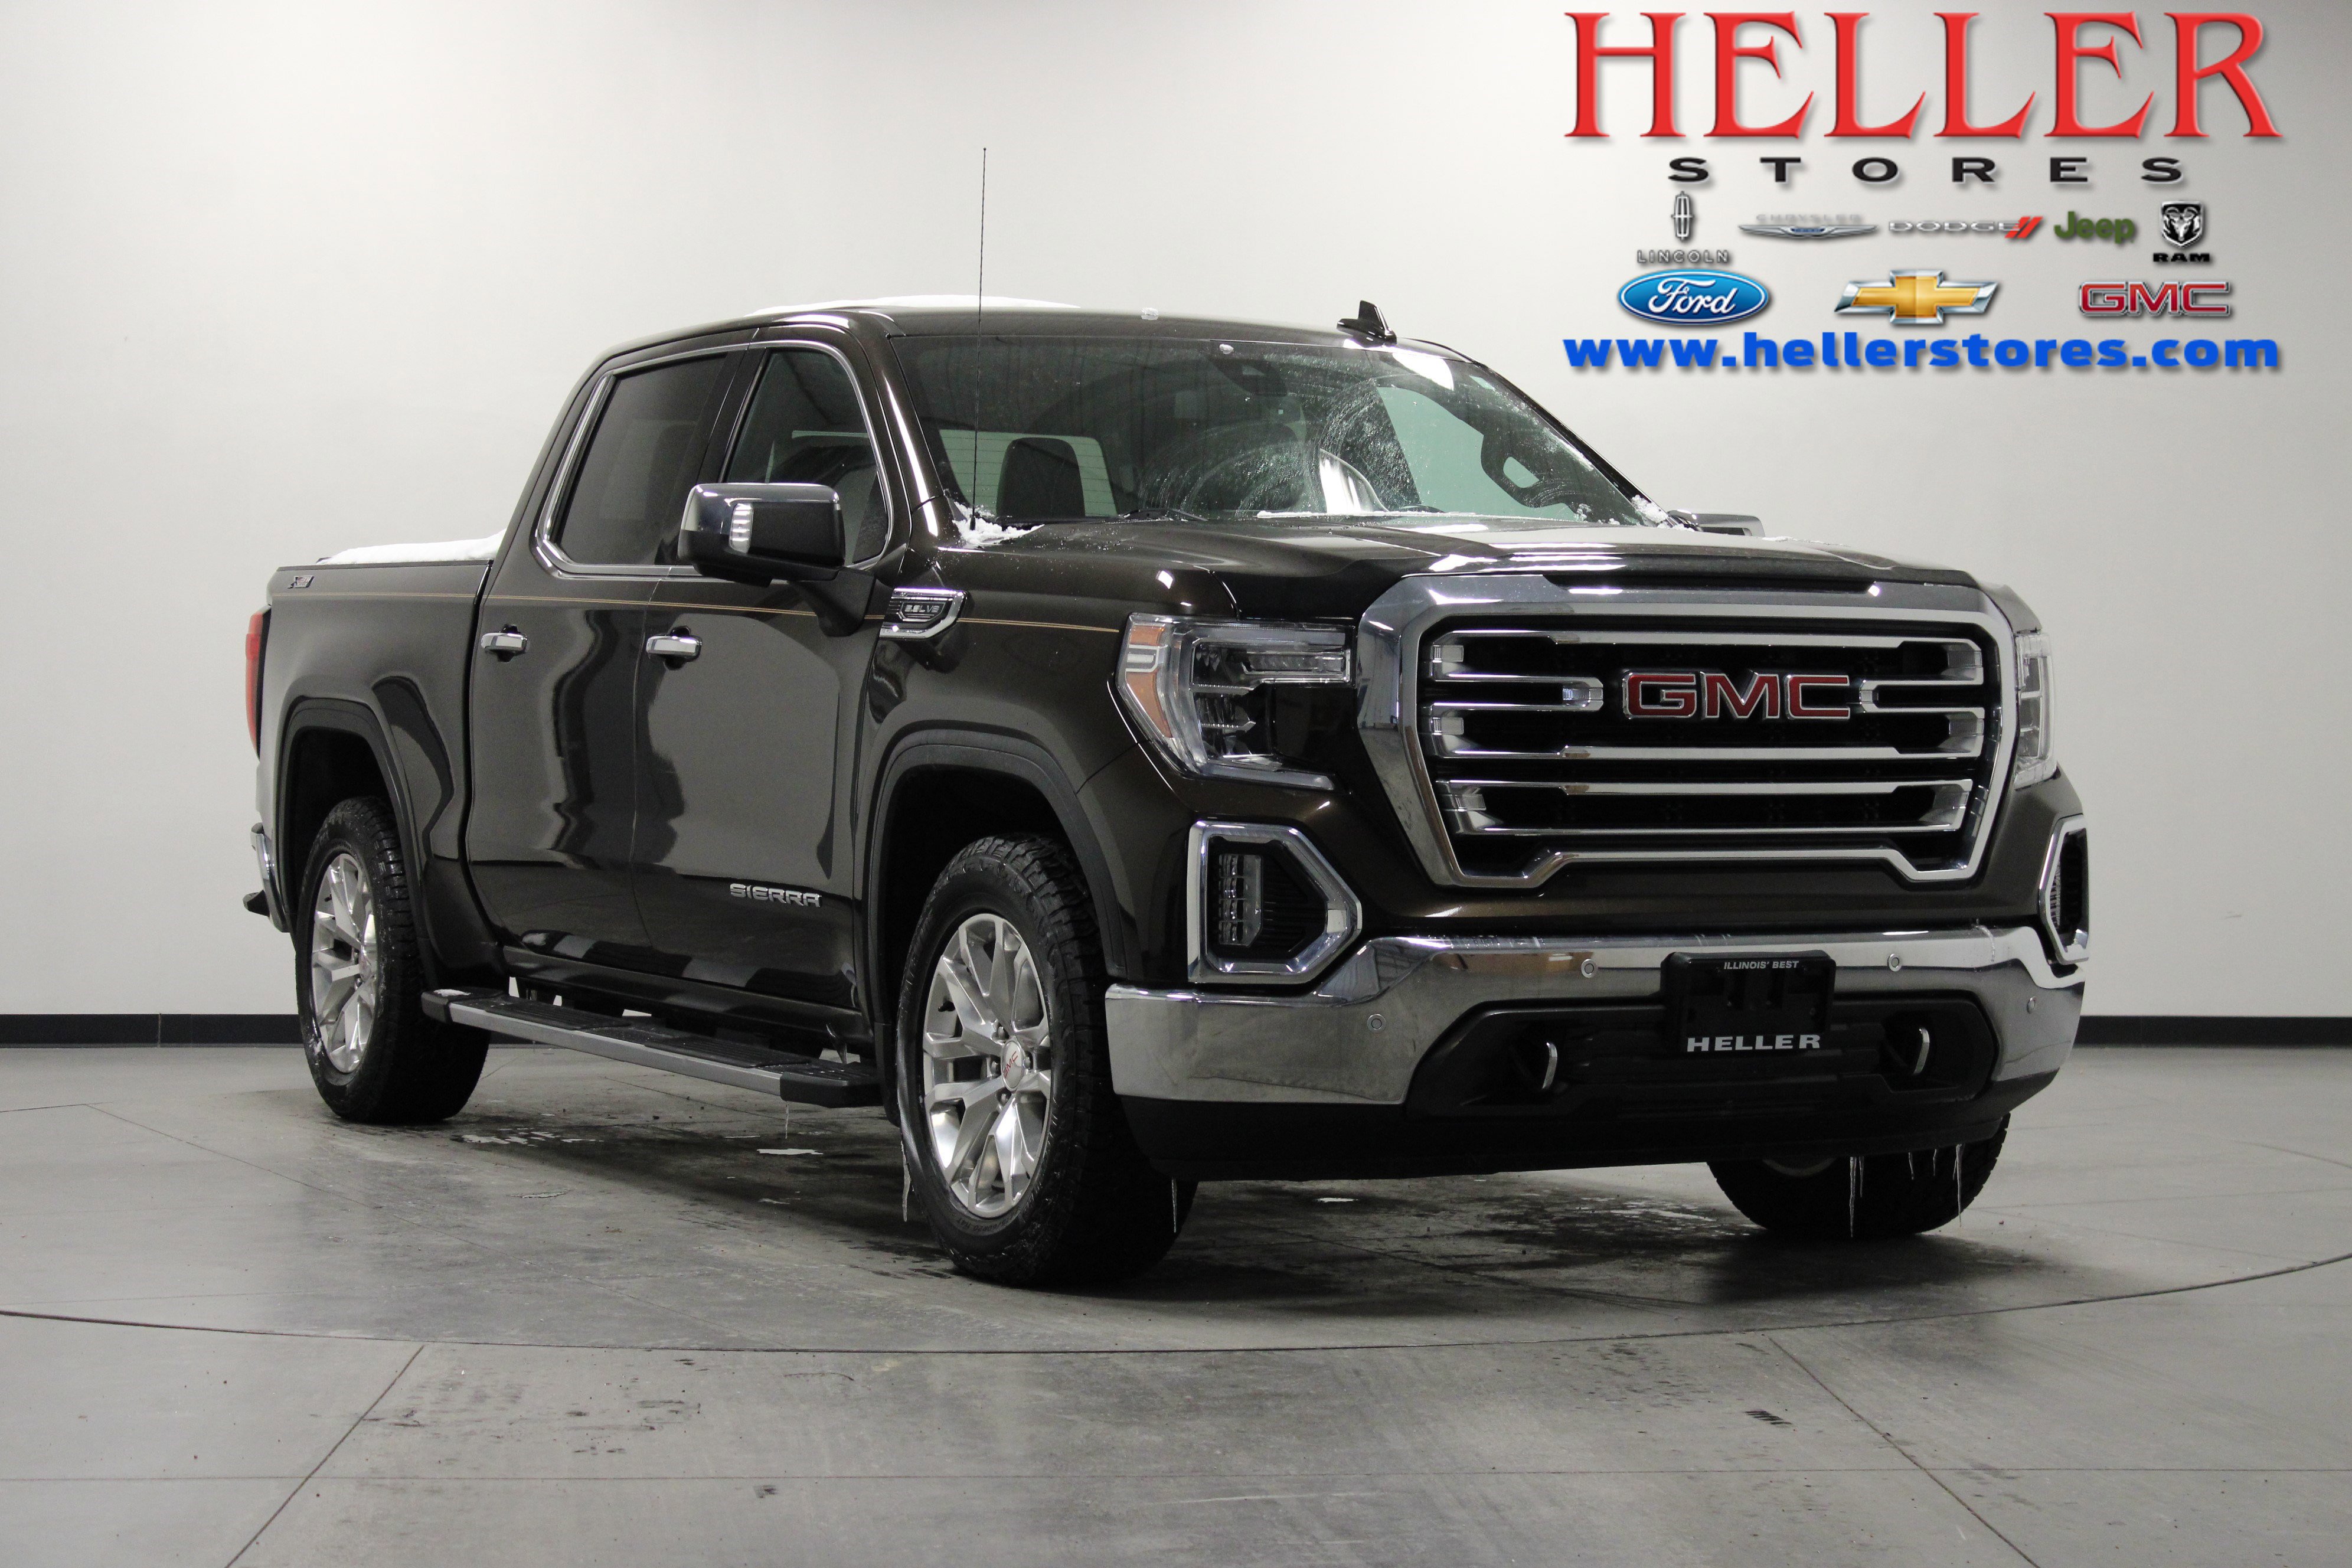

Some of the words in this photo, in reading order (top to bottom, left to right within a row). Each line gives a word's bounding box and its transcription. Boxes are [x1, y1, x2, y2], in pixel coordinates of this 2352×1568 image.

[1622, 671, 1850, 720] GMC
[730, 883, 821, 907] SIERRA
[1772, 961, 1799, 969] BEST
[1687, 1034, 1821, 1052] HELLER
[1004, 1051, 1018, 1079] GMC
